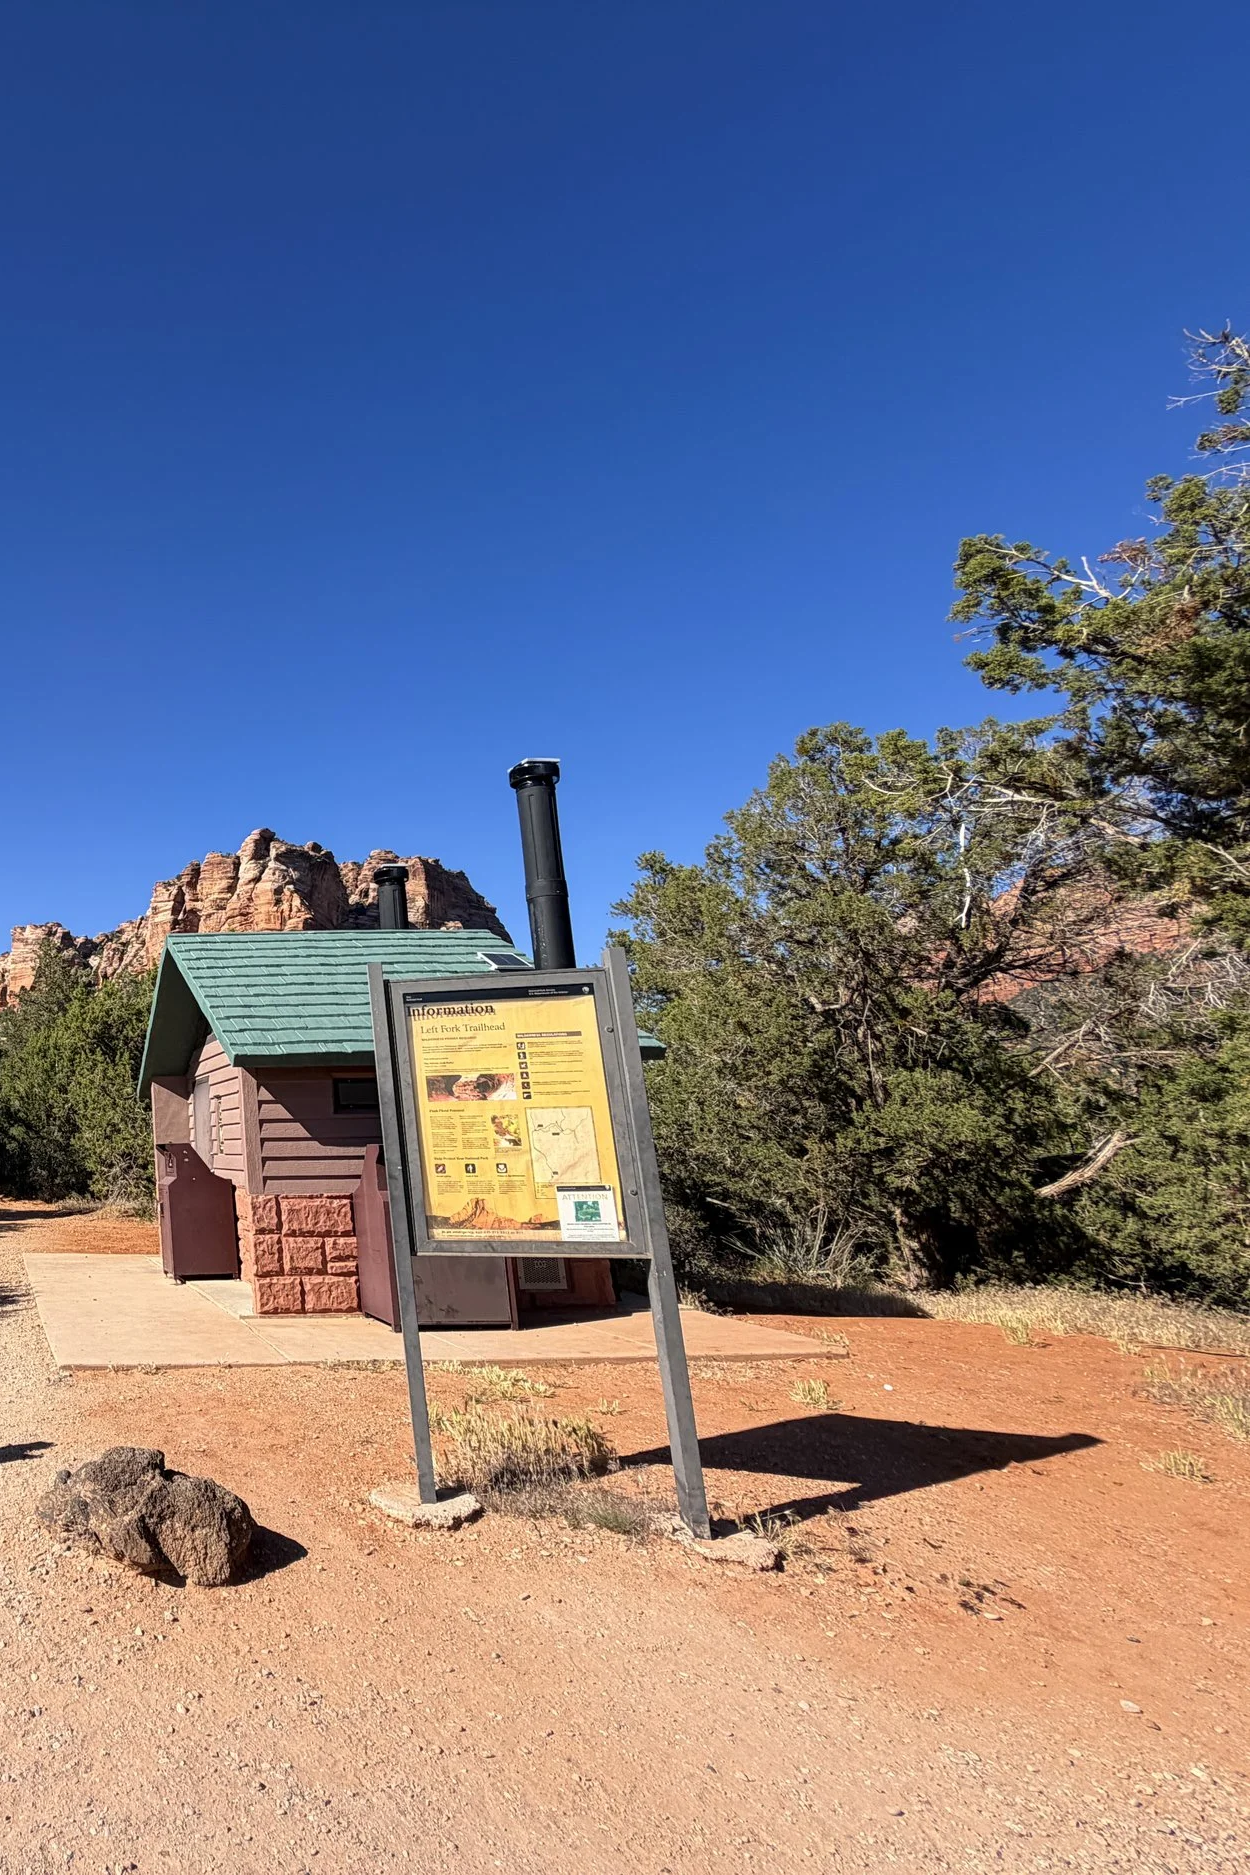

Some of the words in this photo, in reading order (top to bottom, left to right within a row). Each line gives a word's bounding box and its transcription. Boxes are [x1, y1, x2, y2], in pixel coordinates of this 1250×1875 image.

[407, 1003, 495, 1018] Information
[420, 1025, 439, 1034] Left
[441, 1024, 461, 1033] Fork
[462, 1022, 506, 1032] Trailhead
[561, 1193, 609, 1201] ATTENTION
